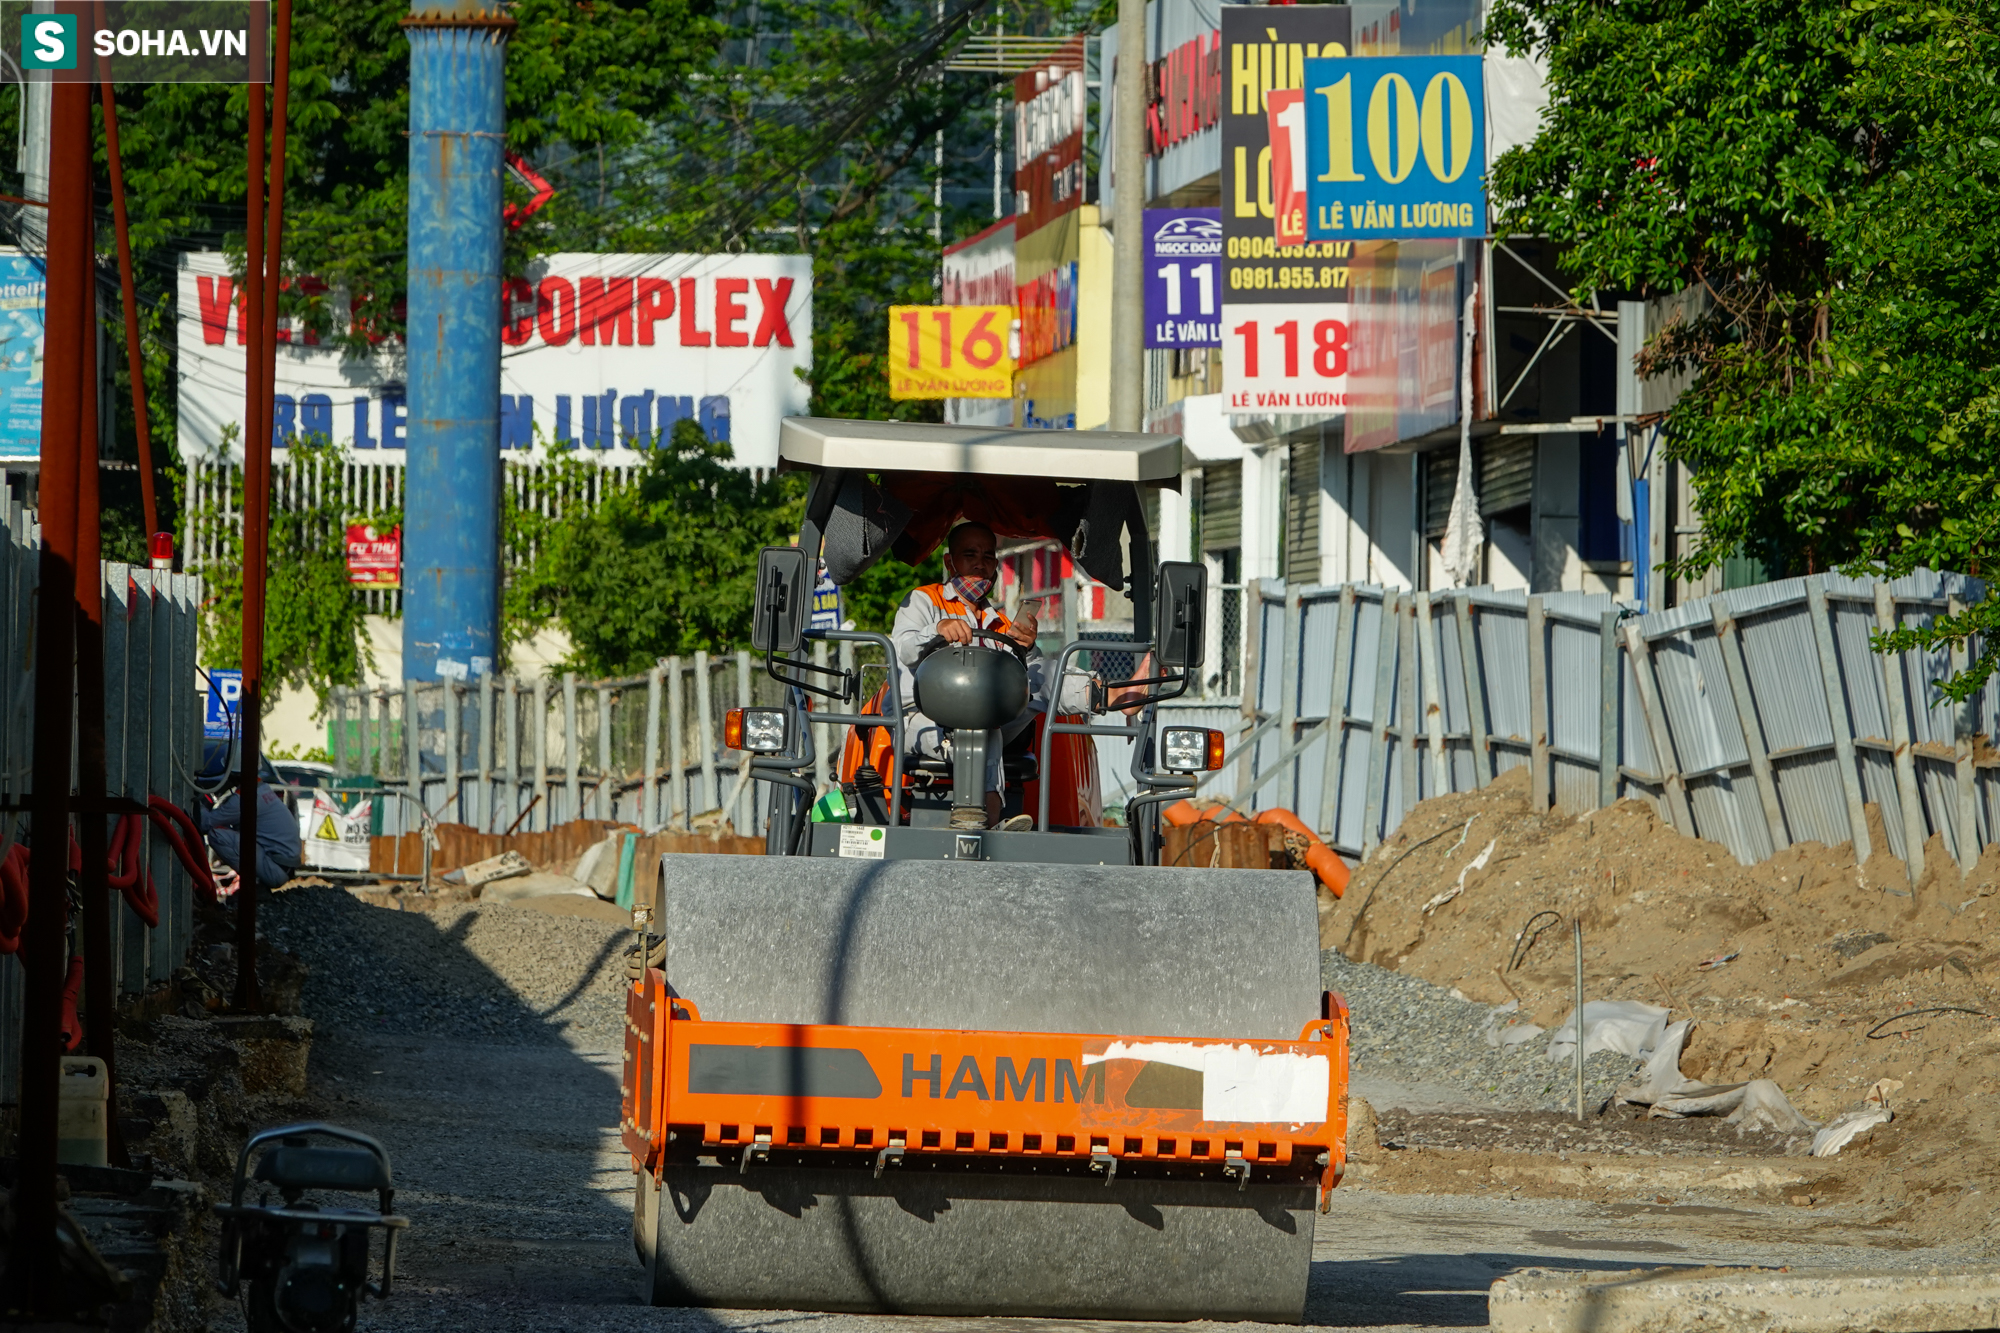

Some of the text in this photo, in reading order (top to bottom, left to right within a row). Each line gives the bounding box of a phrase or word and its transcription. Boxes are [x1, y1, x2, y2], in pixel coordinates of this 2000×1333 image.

[1314, 71, 1473, 185] 100
[1281, 208, 1304, 236] LÊ
[1319, 200, 1473, 229] LÊ VĂN LƯƠNG
[1155, 242, 1189, 255] NGỌC
[1230, 266, 1350, 289] 0981.955.817
[501, 275, 795, 347] COMPLEX
[900, 311, 1004, 370] 116
[1156, 320, 1175, 342] LÊ
[1177, 320, 1208, 342] VĂN
[1234, 319, 1349, 378] 118
[1232, 390, 1249, 407] LÊ
[1257, 390, 1290, 407] VĂN
[901, 1053, 1106, 1105] HAMM
